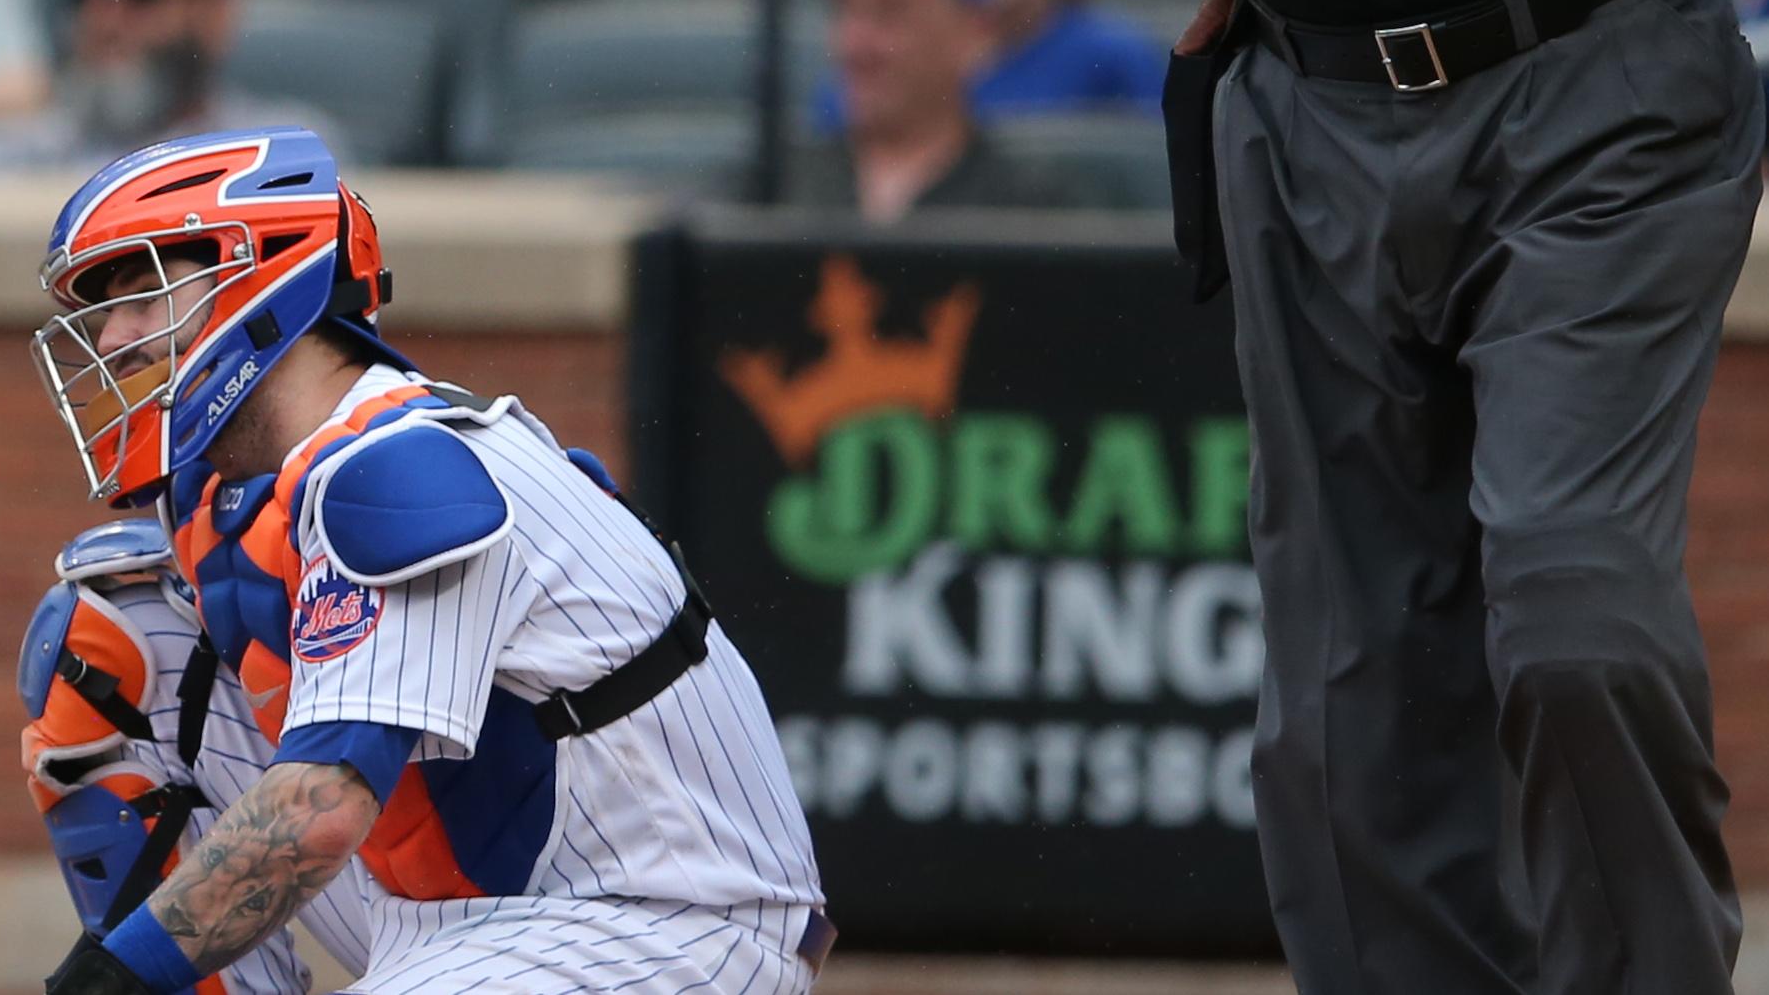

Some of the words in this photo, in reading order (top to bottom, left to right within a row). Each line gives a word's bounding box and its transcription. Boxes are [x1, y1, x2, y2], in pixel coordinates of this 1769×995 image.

[207, 356, 259, 426] ALL-STAR
[300, 591, 365, 639] Mets
[843, 542, 1265, 705] KING
